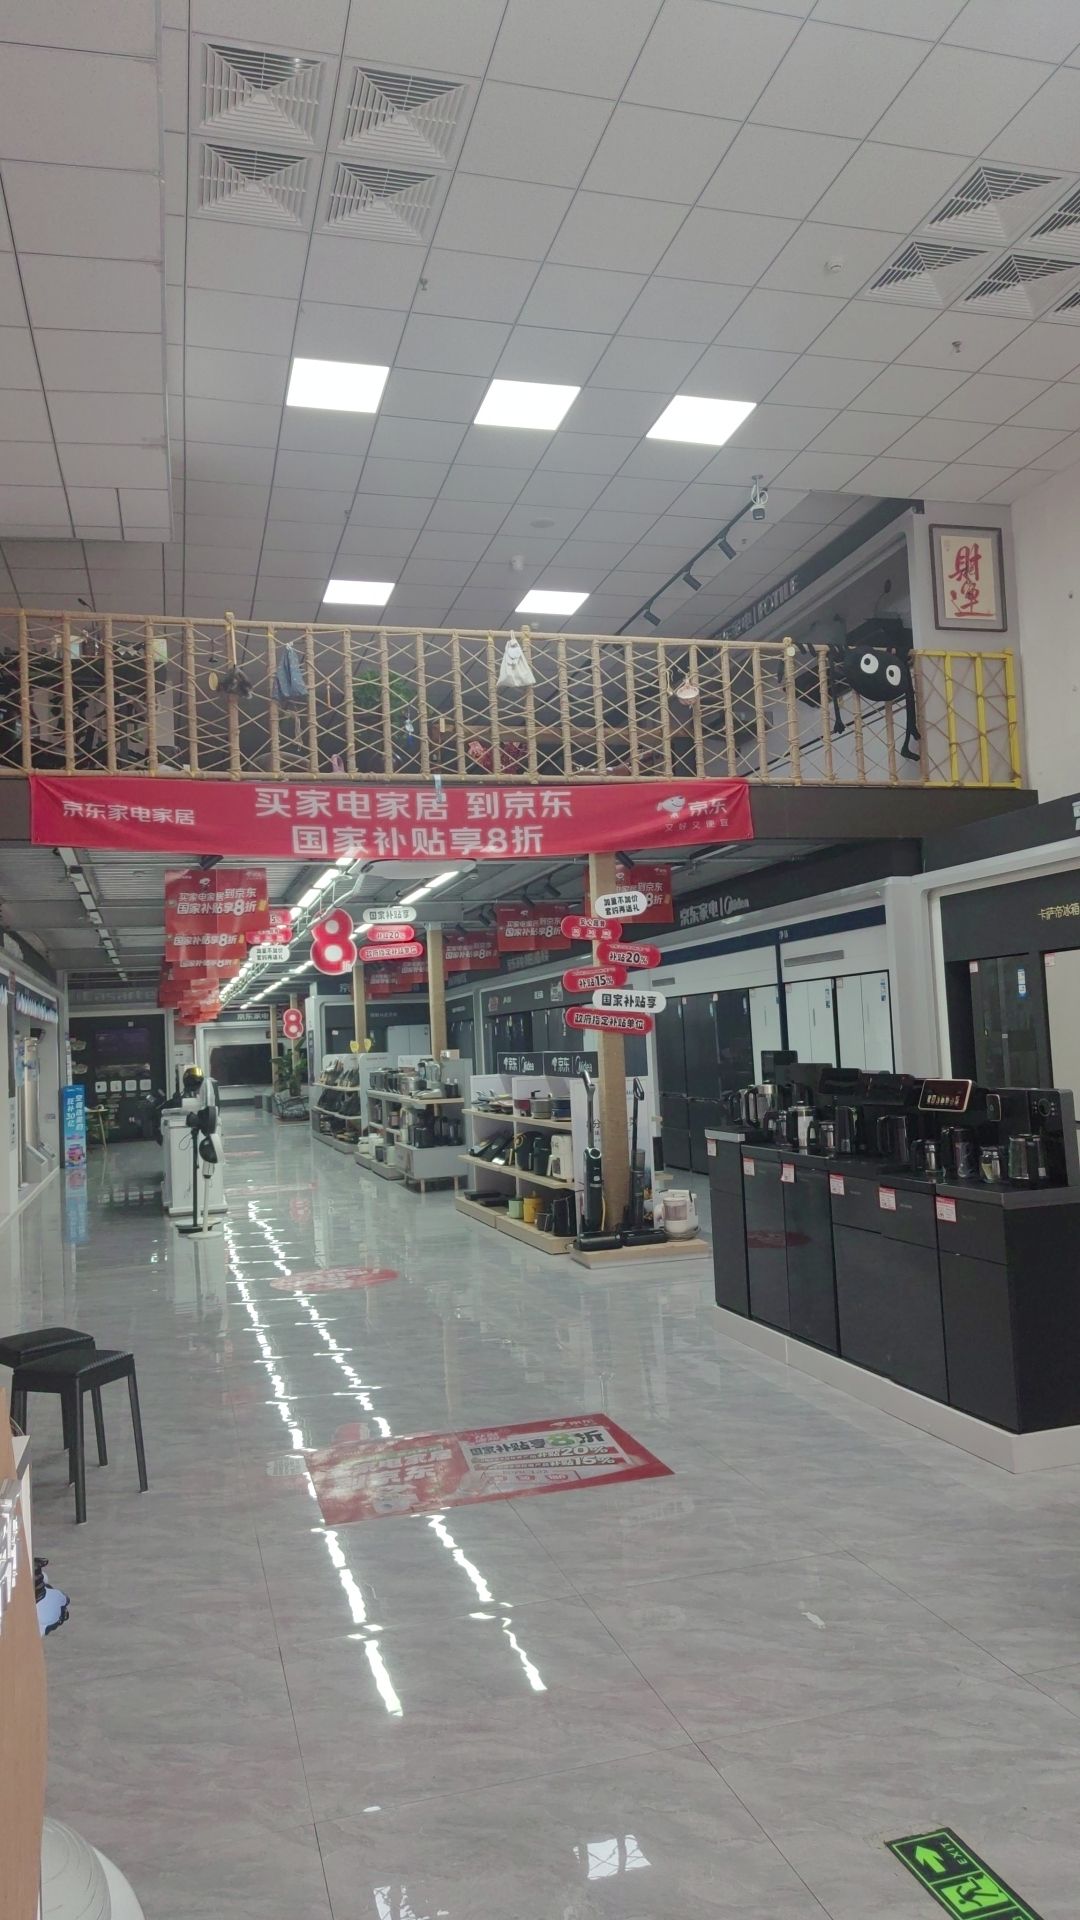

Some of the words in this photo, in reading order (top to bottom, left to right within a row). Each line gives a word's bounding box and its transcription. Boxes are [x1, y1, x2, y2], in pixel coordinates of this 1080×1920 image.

[255, 786, 449, 821] 买家电家居
[466, 790, 573, 820] 到京东
[687, 797, 728, 817] 京东
[61, 800, 195, 826] 京东家电家居
[664, 818, 729, 832] 又好又便宜
[291, 825, 544, 856] 国家补贴享8折
[177, 899, 257, 916] 国家补贴享8折
[608, 951, 649, 965] 补贴20%
[578, 975, 614, 989] 补贴15%
[601, 993, 657, 1008] 国家补贴享
[574, 1013, 645, 1030] 政府指定补贴单位
[470, 1430, 606, 1456] 国家补贴享8折
[940, 1842, 968, 1865] EXIT
